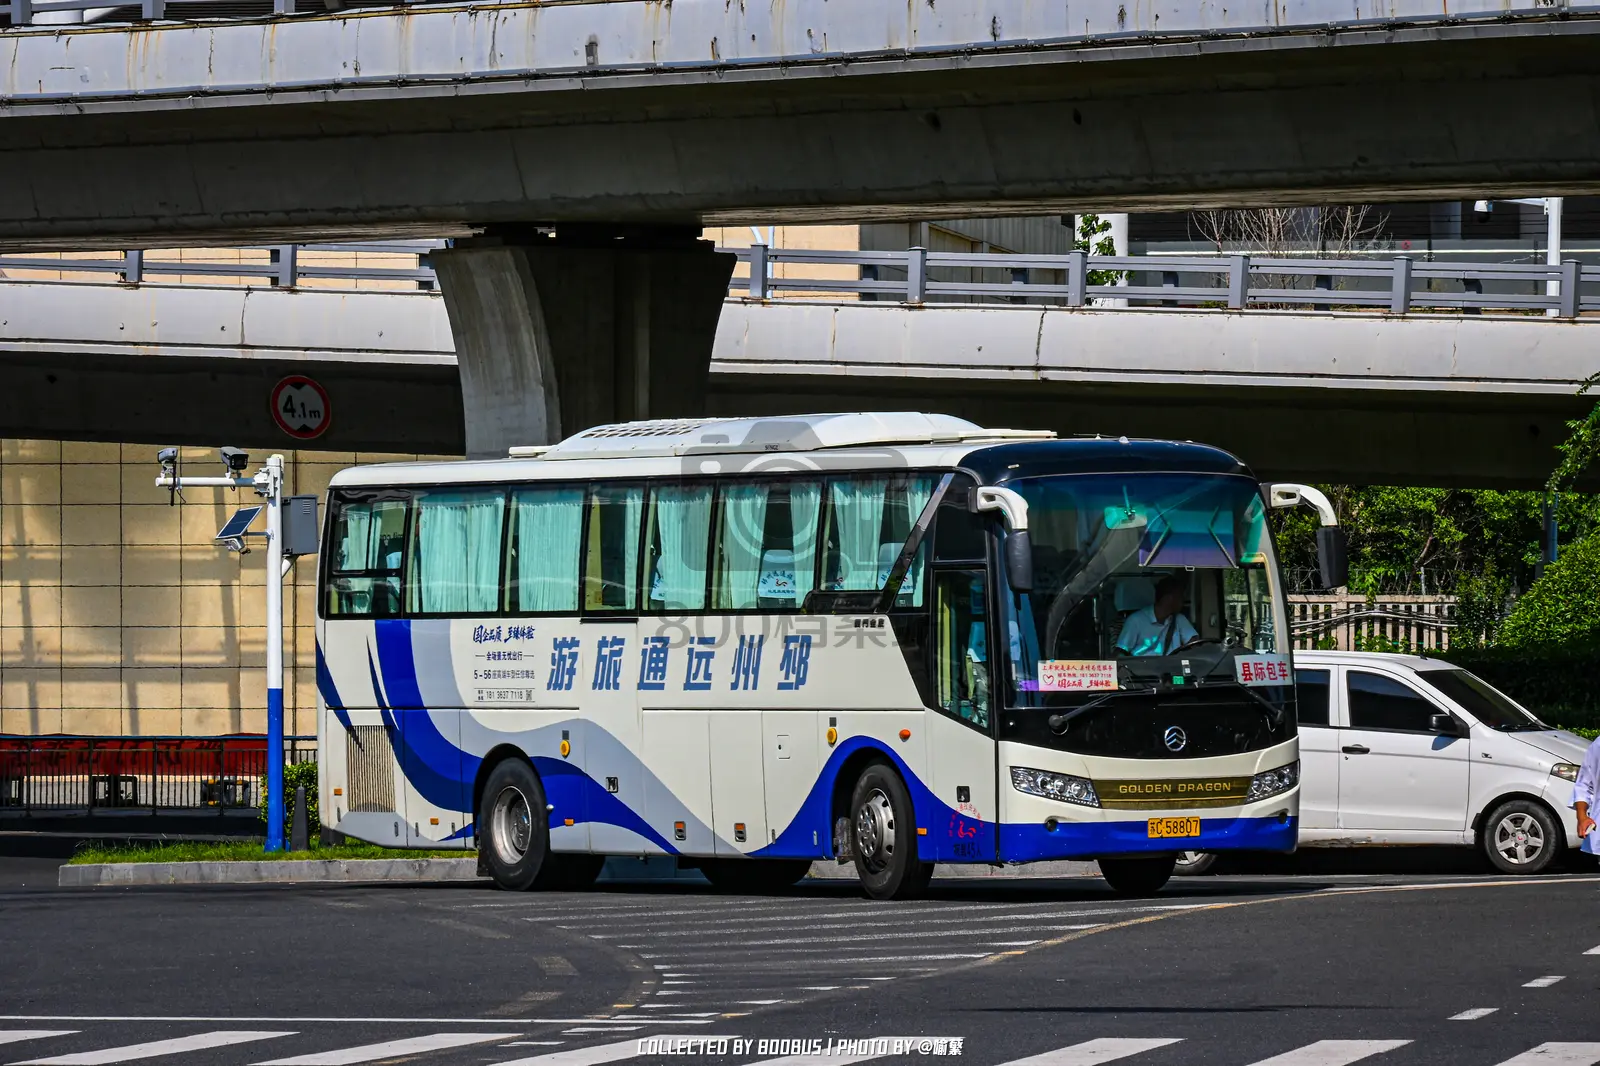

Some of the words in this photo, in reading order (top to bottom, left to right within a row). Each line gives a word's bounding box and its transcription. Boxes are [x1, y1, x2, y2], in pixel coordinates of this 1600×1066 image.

[282, 394, 321, 418] 4.1m
[1241, 661, 1288, 681] 县际包车
[1119, 784, 1172, 794] GOLDEN
[1178, 782, 1231, 792] DRAGON
